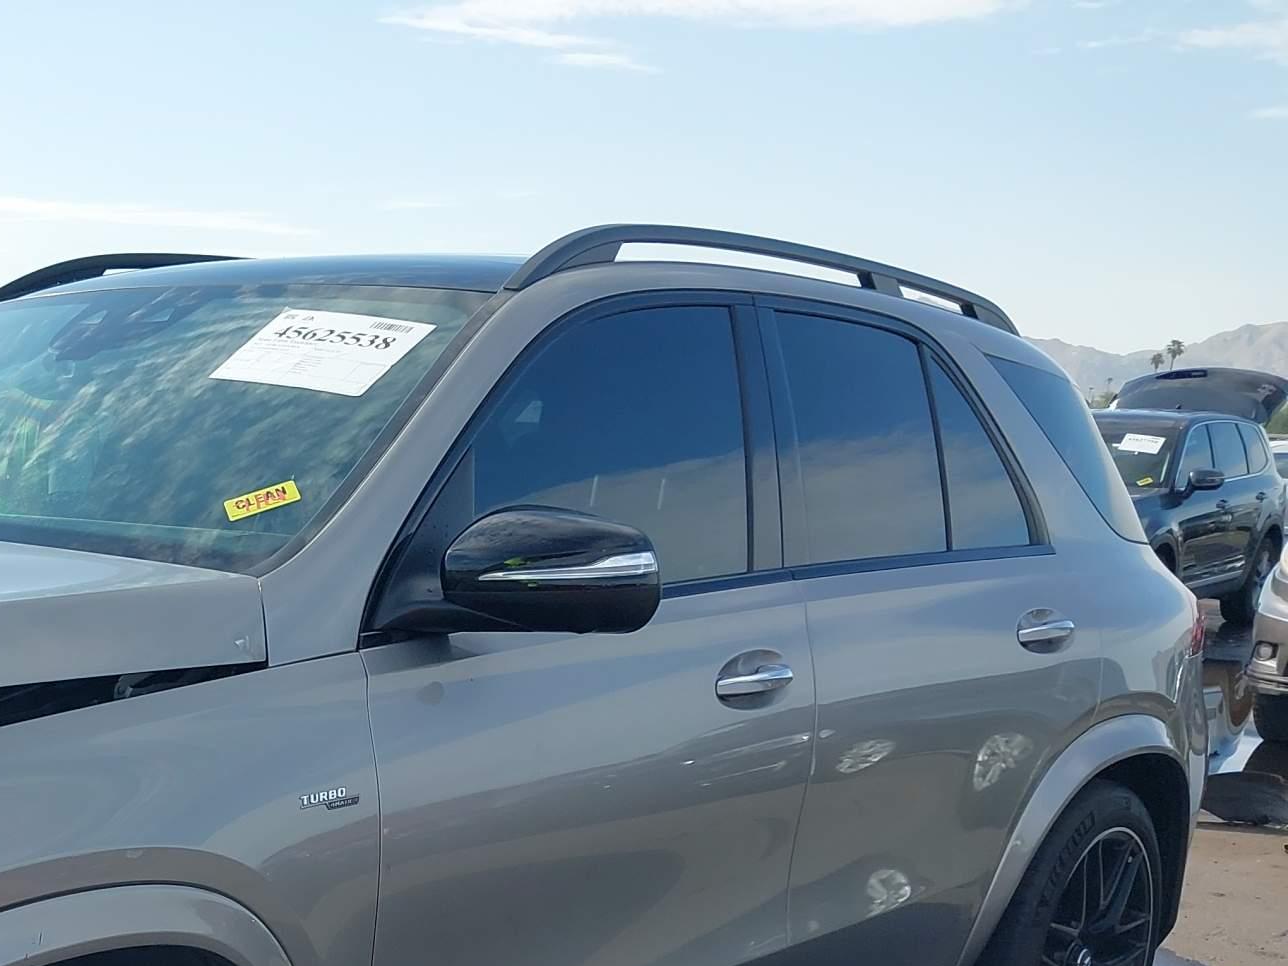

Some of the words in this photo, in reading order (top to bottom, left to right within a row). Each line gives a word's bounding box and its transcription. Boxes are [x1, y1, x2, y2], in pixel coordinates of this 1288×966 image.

[273, 325, 396, 350] 45625538
[235, 486, 287, 510] CLEAN
[300, 787, 346, 805] TURBO
